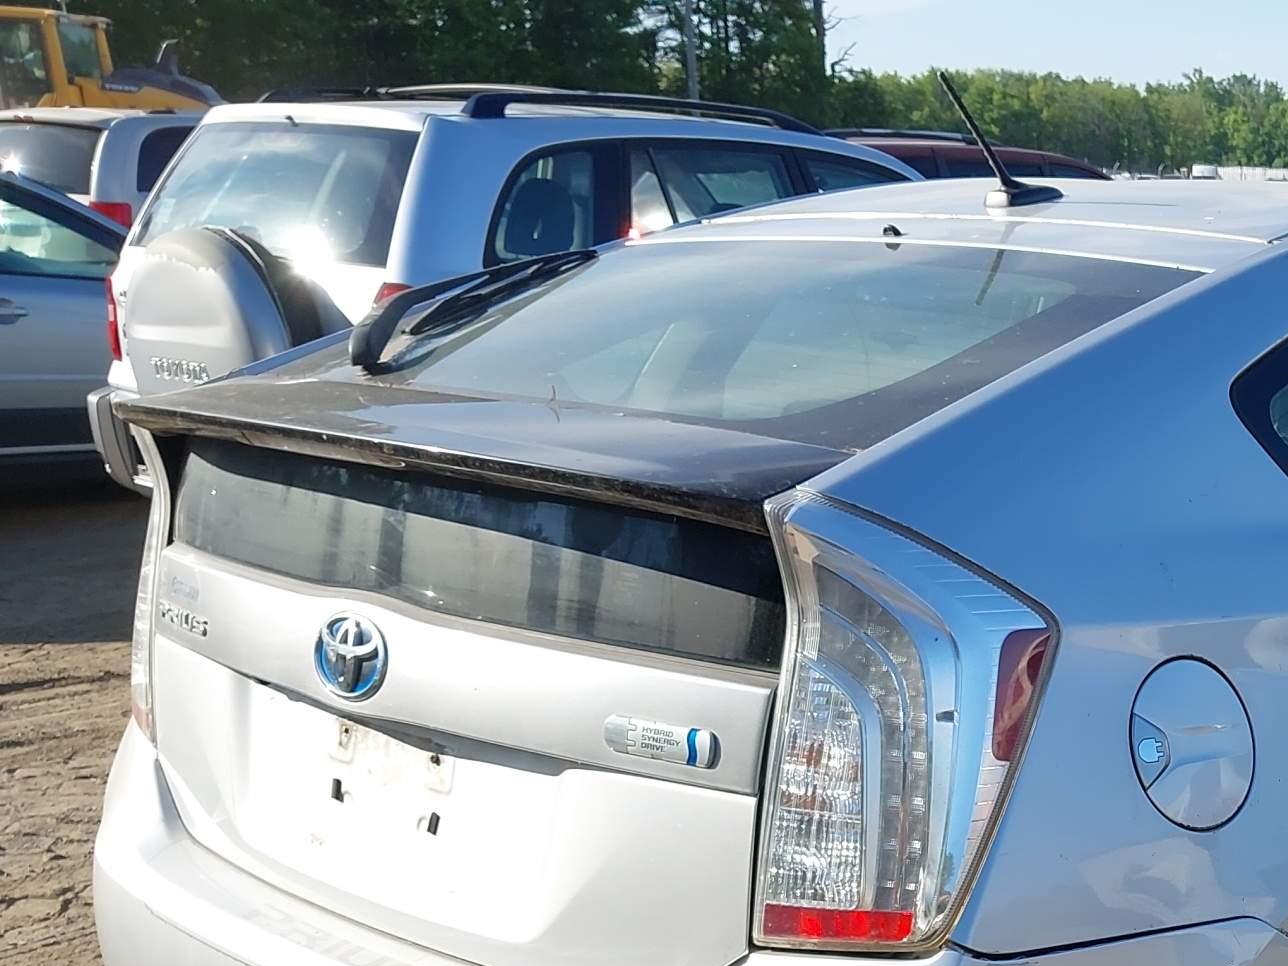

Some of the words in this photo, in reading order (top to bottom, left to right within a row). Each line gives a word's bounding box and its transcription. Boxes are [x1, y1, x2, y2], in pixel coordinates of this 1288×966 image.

[150, 357, 210, 384] TOYOTA
[159, 601, 209, 637] PRIUS
[641, 726, 674, 738] HYBRID
[641, 734, 681, 747] SYNERGY
[640, 742, 666, 753] DRIVE
